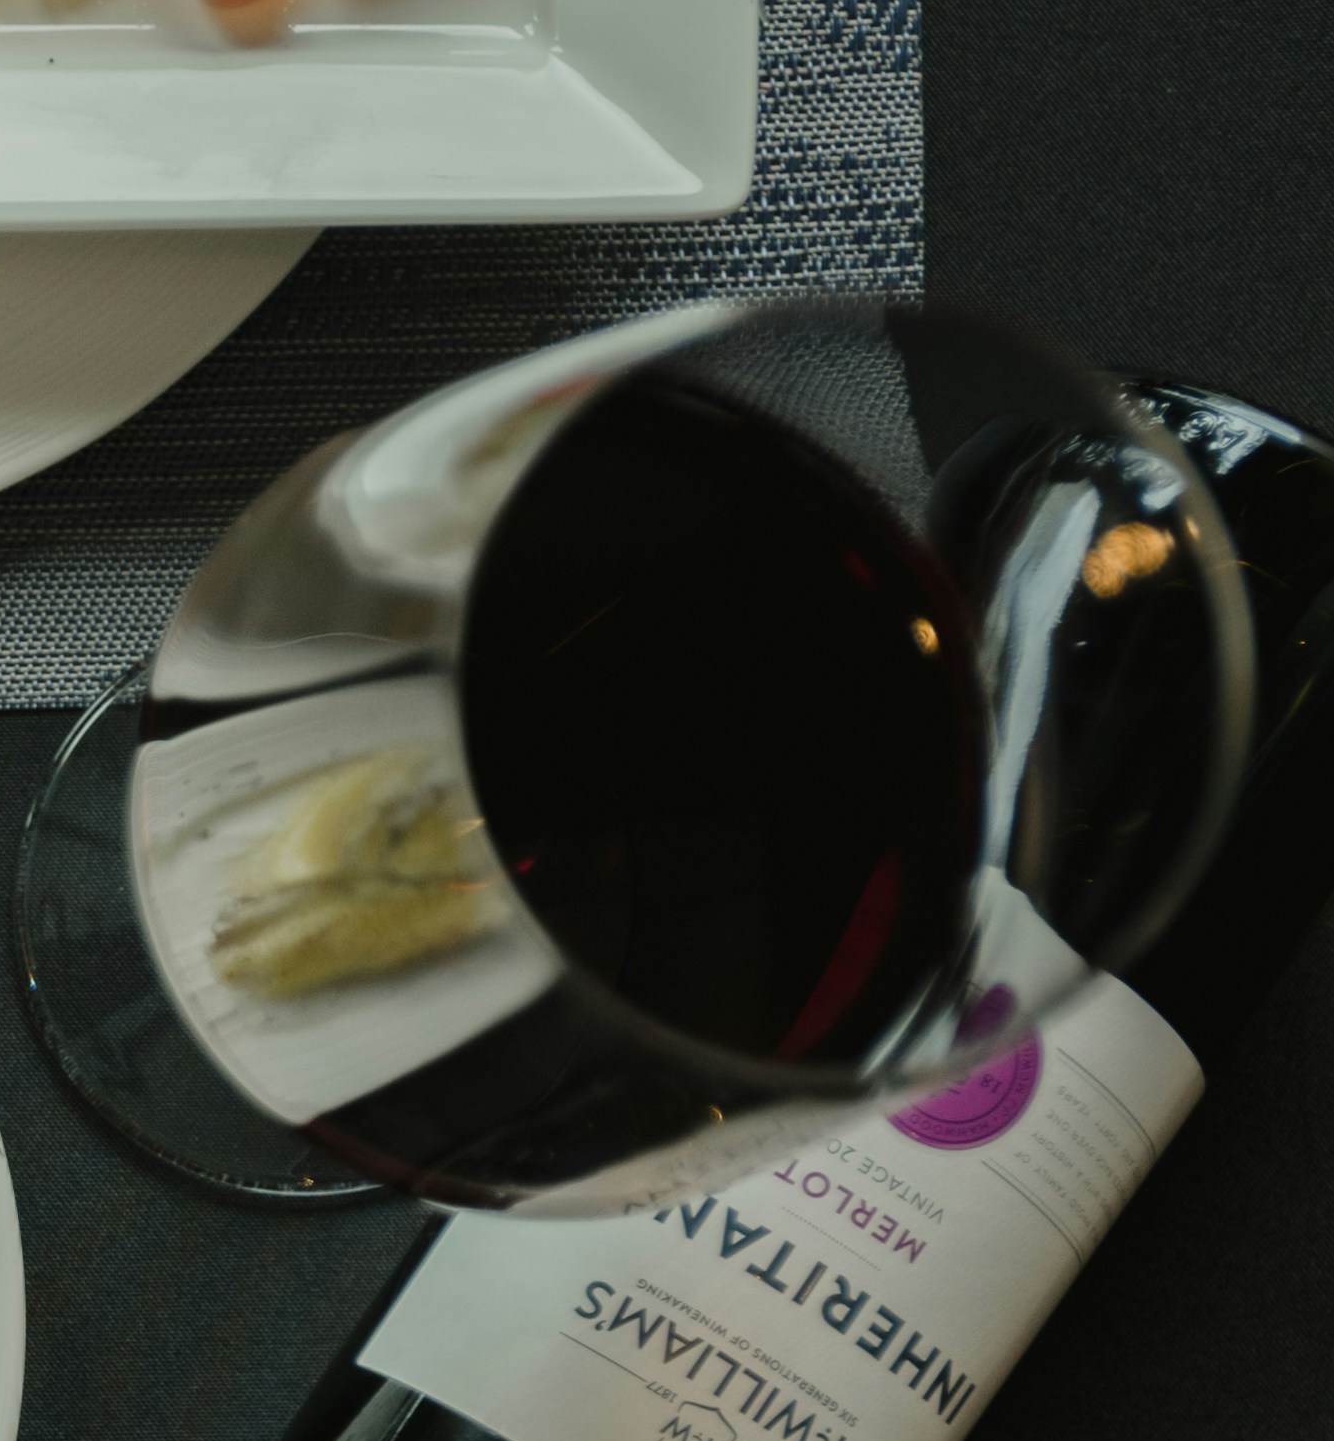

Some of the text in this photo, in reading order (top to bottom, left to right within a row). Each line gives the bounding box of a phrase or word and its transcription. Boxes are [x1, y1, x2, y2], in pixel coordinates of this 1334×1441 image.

[1057, 1086, 1090, 1119] YEARS
[1013, 1150, 1032, 1165] OF
[1031, 1132, 1074, 1169] HISTORY
[827, 1136, 944, 1224] VINTAGE 20
[1034, 1167, 1067, 1199] FAMILY
[773, 1160, 927, 1264] MERLOT
[654, 1194, 975, 1424] INHERITAN
[636, 1278, 859, 1427] SIX GENERATIONS OF WINEMAKING
[645, 1381, 677, 1403] 1877
